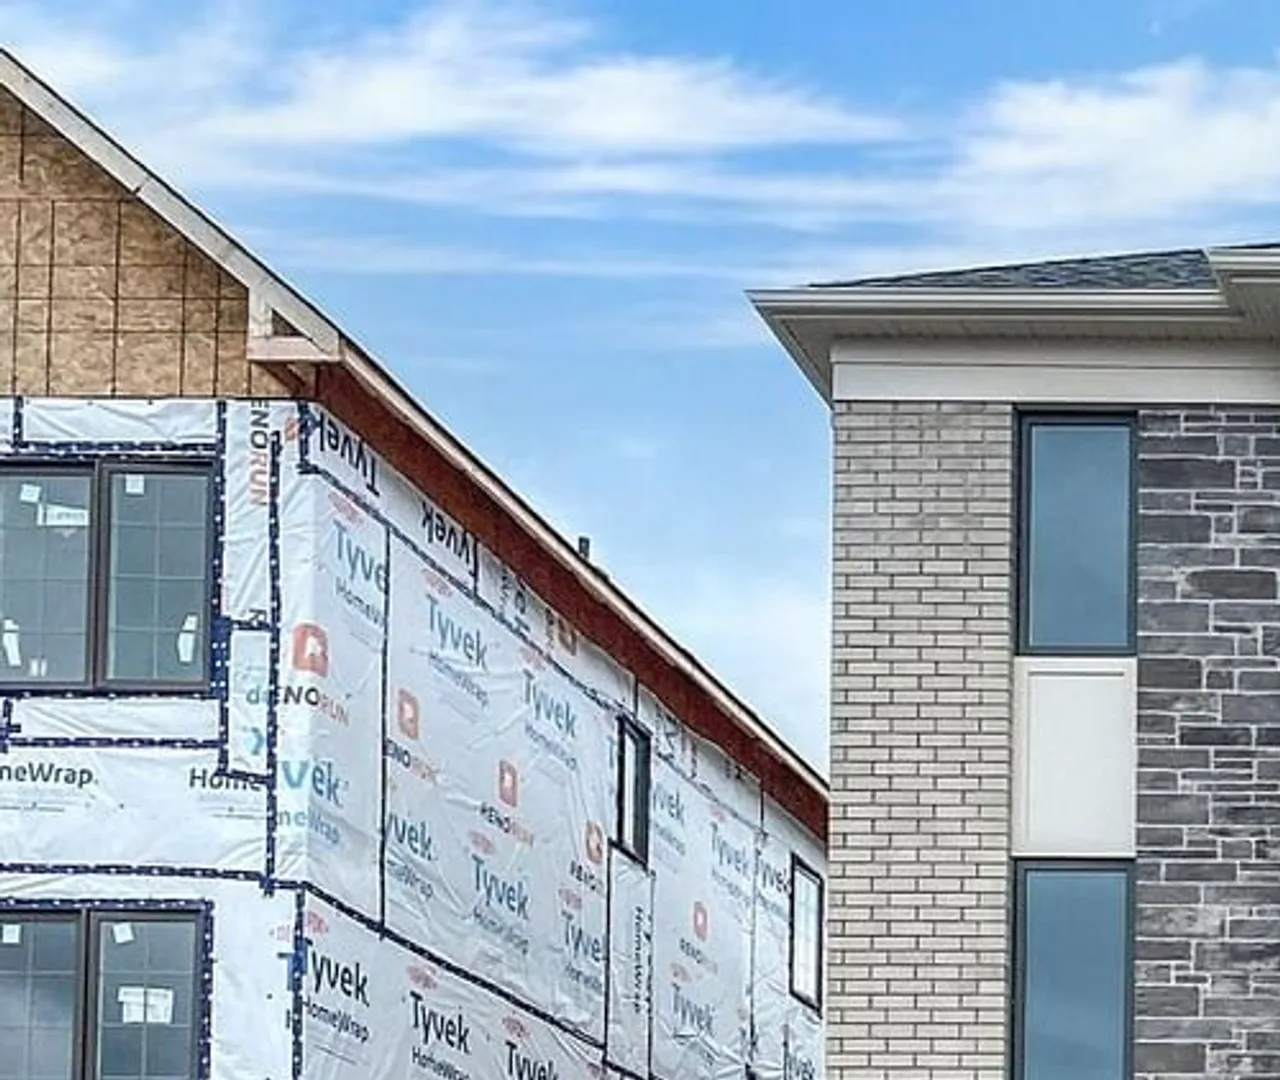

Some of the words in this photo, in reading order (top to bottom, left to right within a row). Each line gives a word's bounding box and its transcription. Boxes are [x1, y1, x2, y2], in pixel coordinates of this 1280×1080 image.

[333, 519, 386, 592] Tyve
[426, 594, 487, 671] Tyvek
[523, 668, 577, 738] Tyvek
[472, 853, 529, 919] Tyvek
[410, 990, 471, 1055] Tyvek
